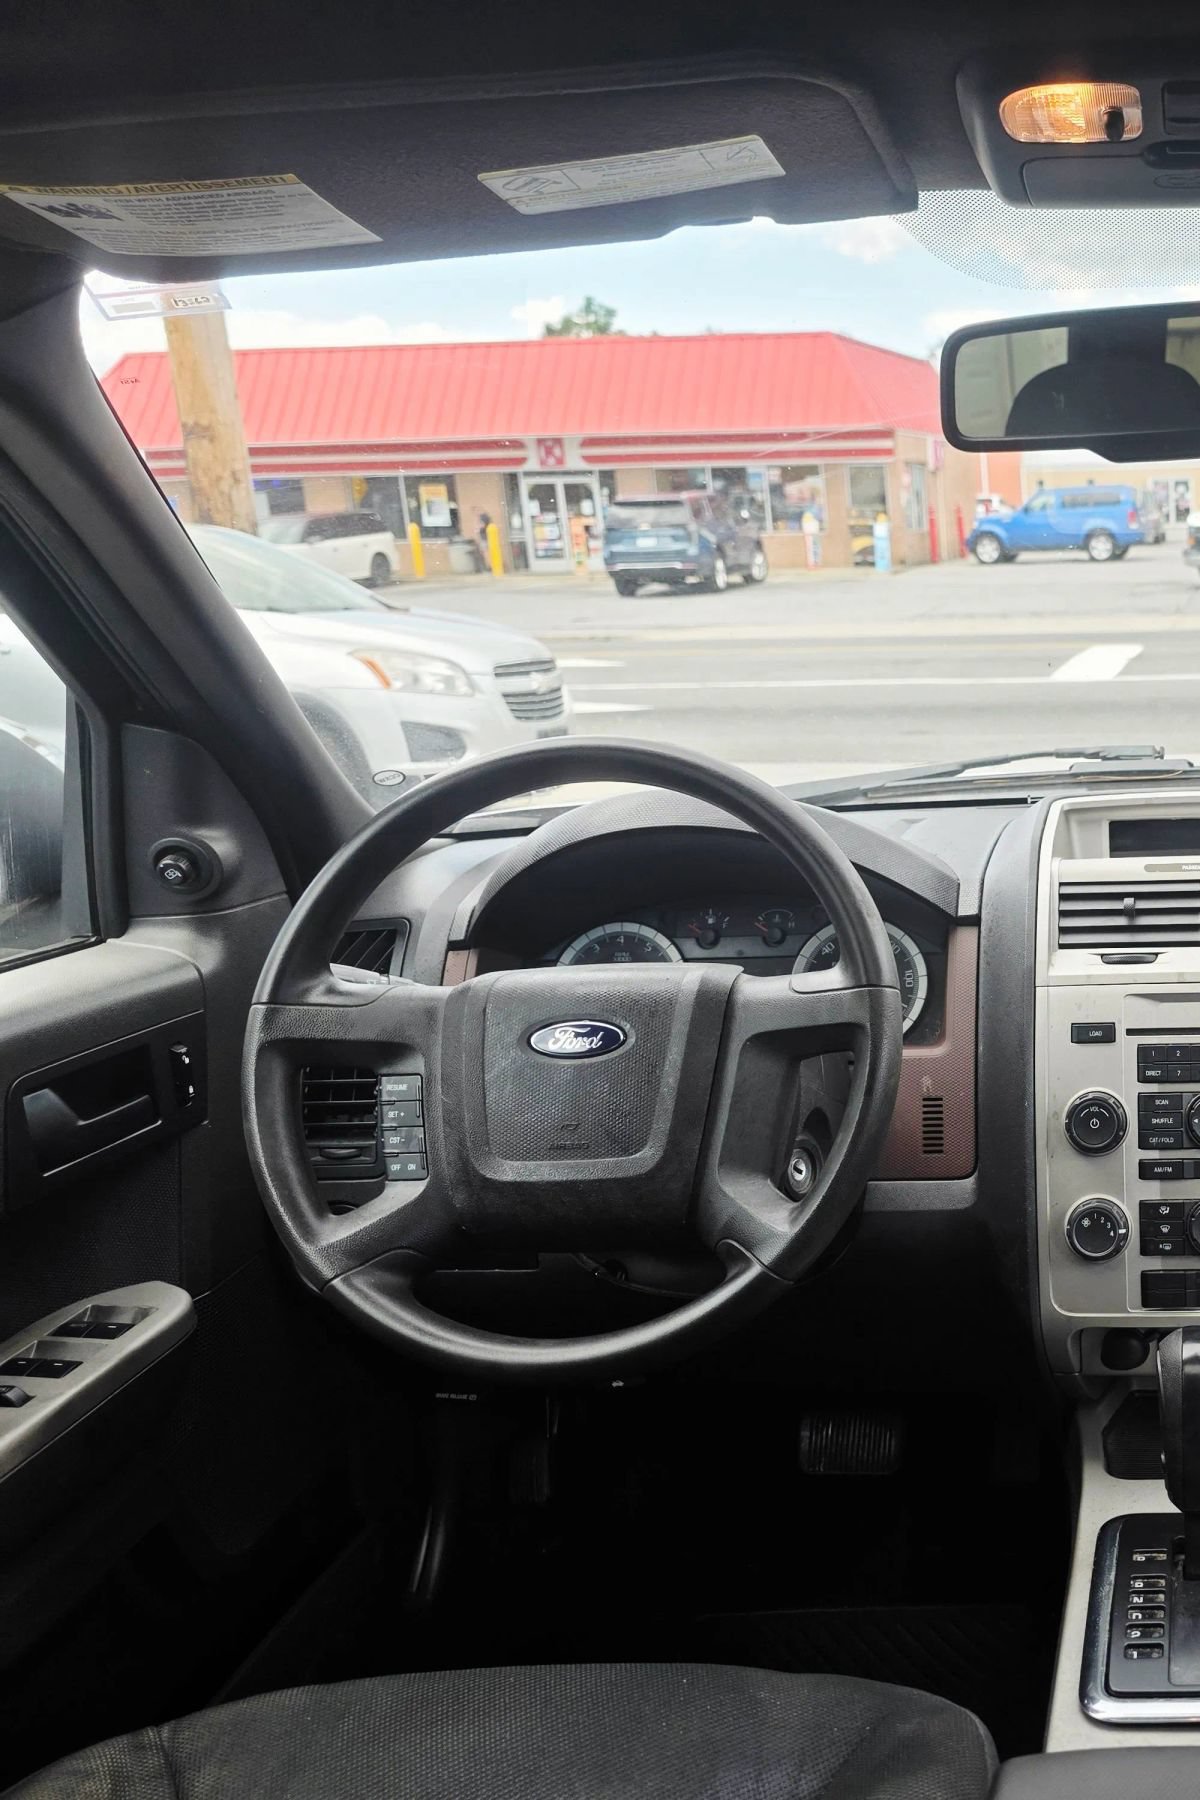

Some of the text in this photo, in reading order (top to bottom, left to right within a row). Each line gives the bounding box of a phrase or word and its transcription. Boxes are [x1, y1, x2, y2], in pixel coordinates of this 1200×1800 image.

[616, 935, 625, 944] 4
[591, 943, 600, 953] 3
[644, 942, 653, 953] 5
[821, 941, 836, 956] 40
[904, 969, 914, 988] 100
[547, 1026, 605, 1050] Ford
[1151, 1117, 1174, 1125] SHUFFLE
[407, 1163, 416, 1171] ON
